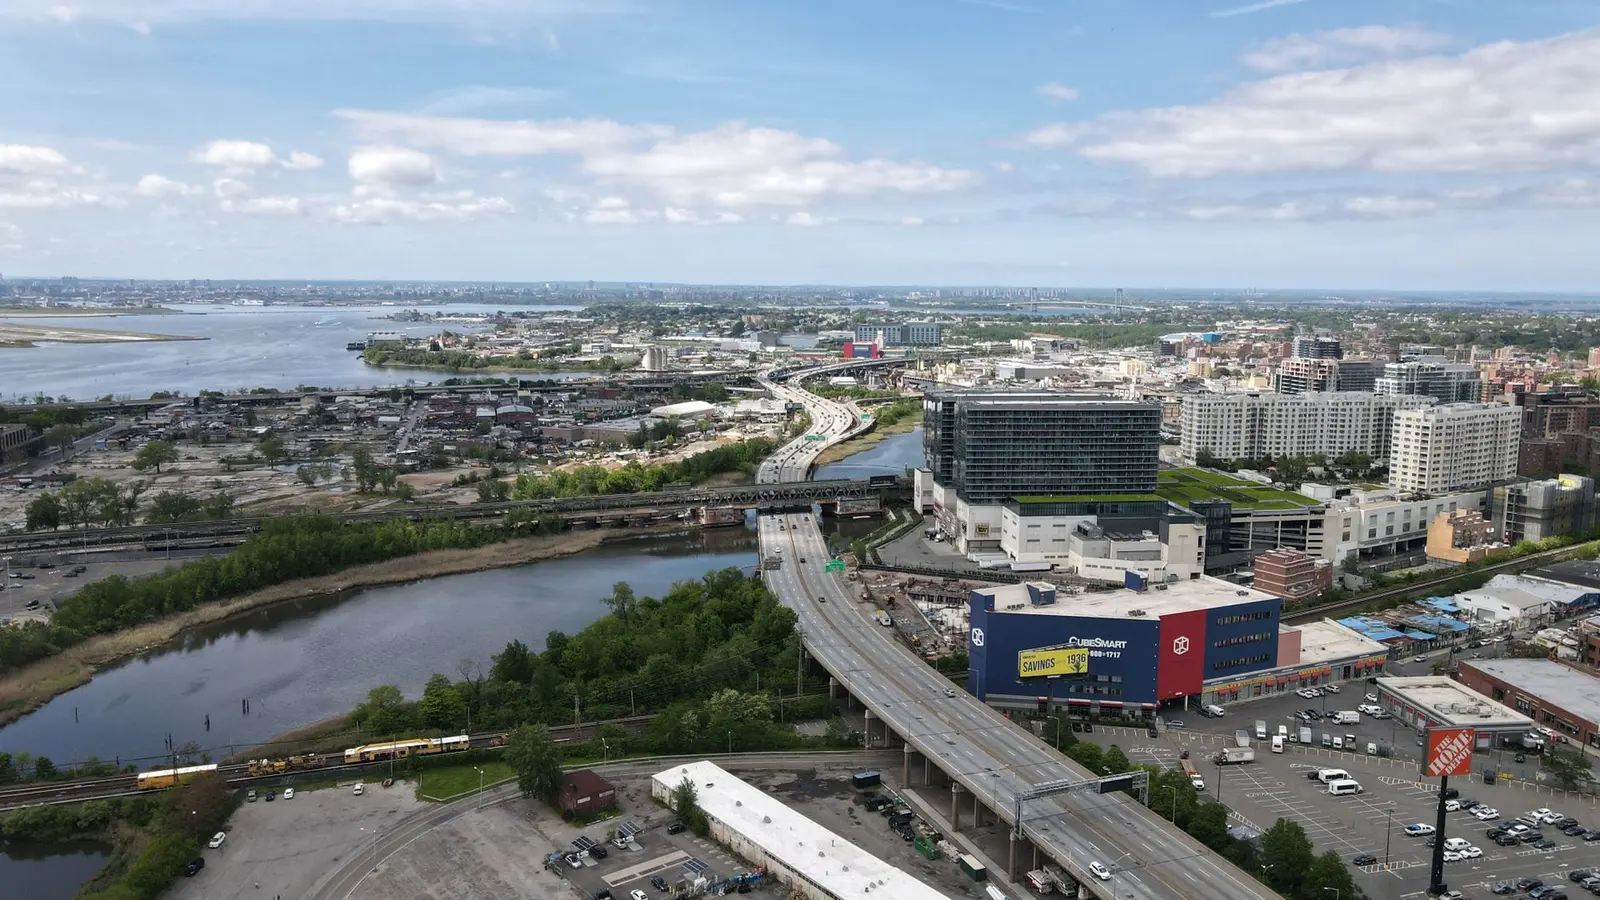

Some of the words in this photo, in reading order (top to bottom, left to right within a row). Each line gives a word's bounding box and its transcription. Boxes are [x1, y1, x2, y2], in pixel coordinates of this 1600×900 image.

[1023, 658, 1055, 672] SAVINGS
[1067, 653, 1086, 665] 1936
[1429, 730, 1472, 775] HOME
[1434, 735, 1453, 753] THE
[1445, 746, 1471, 774] DEPOT
